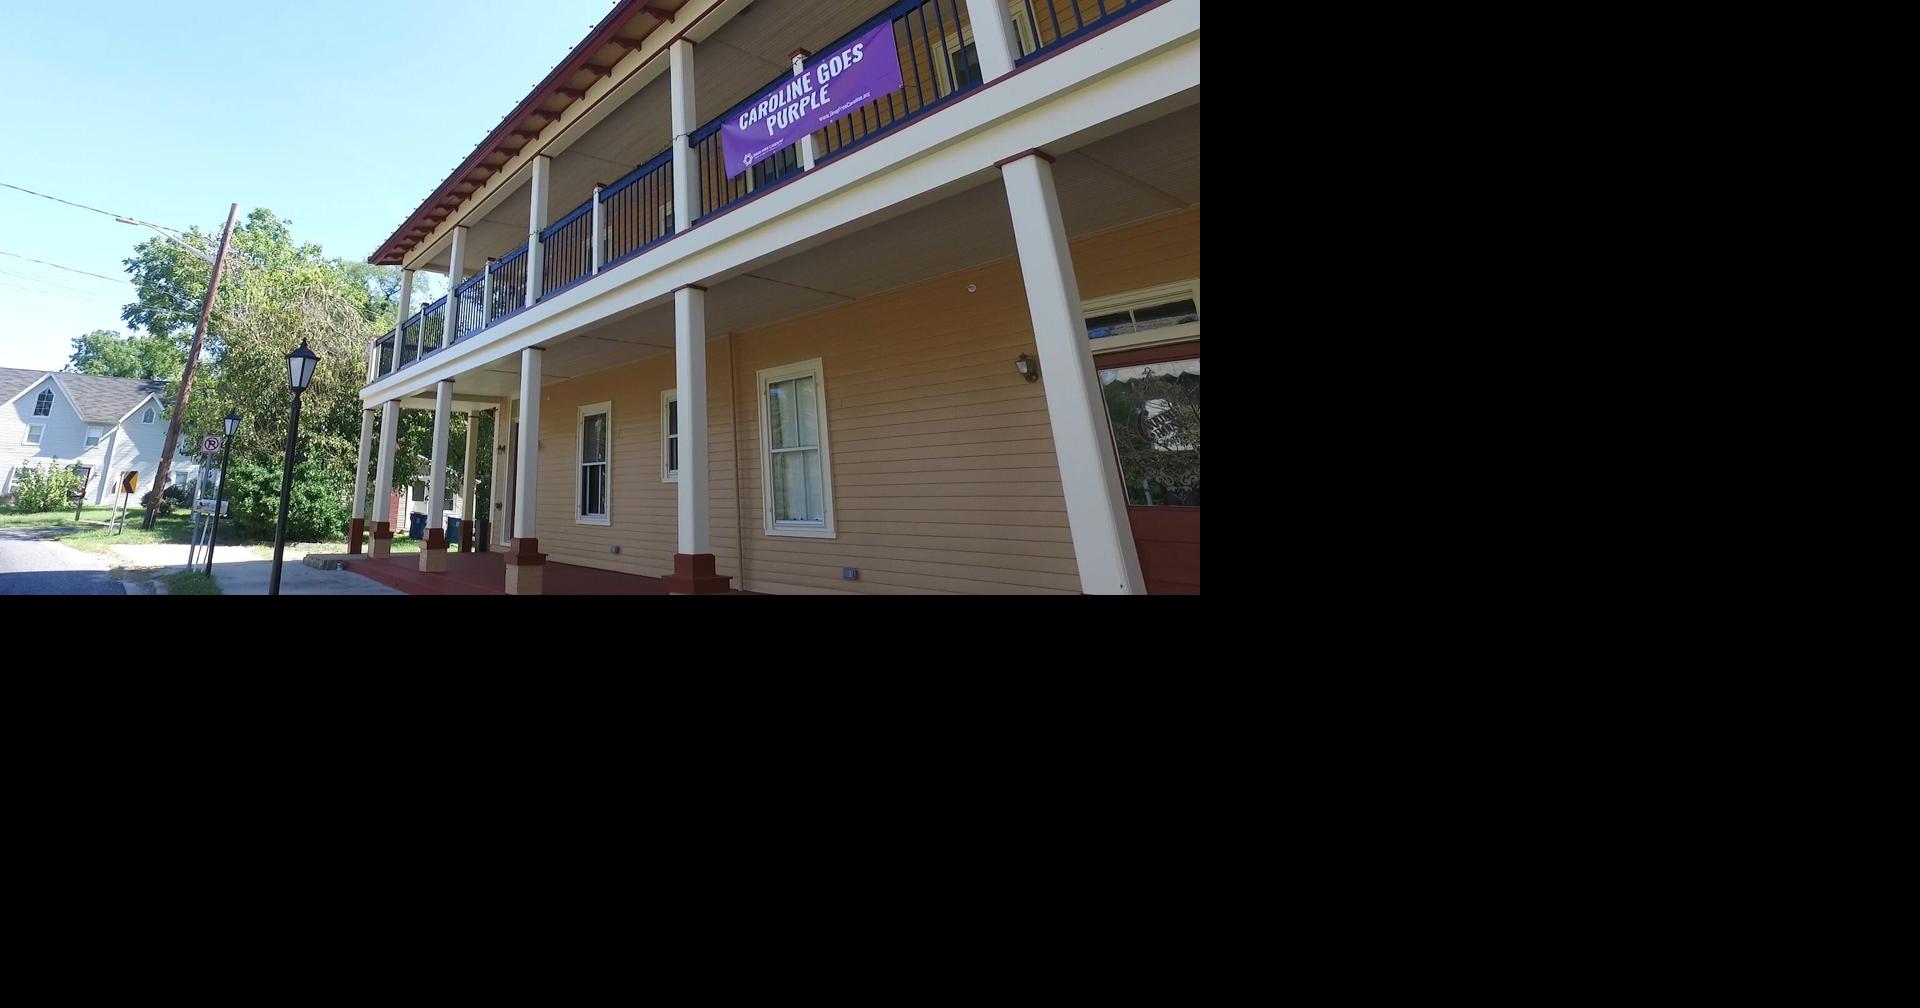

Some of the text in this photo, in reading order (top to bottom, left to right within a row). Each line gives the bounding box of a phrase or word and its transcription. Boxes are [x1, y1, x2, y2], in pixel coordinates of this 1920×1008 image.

[739, 43, 864, 130] CAROLINE GOES
[766, 83, 831, 136] PURPLE
